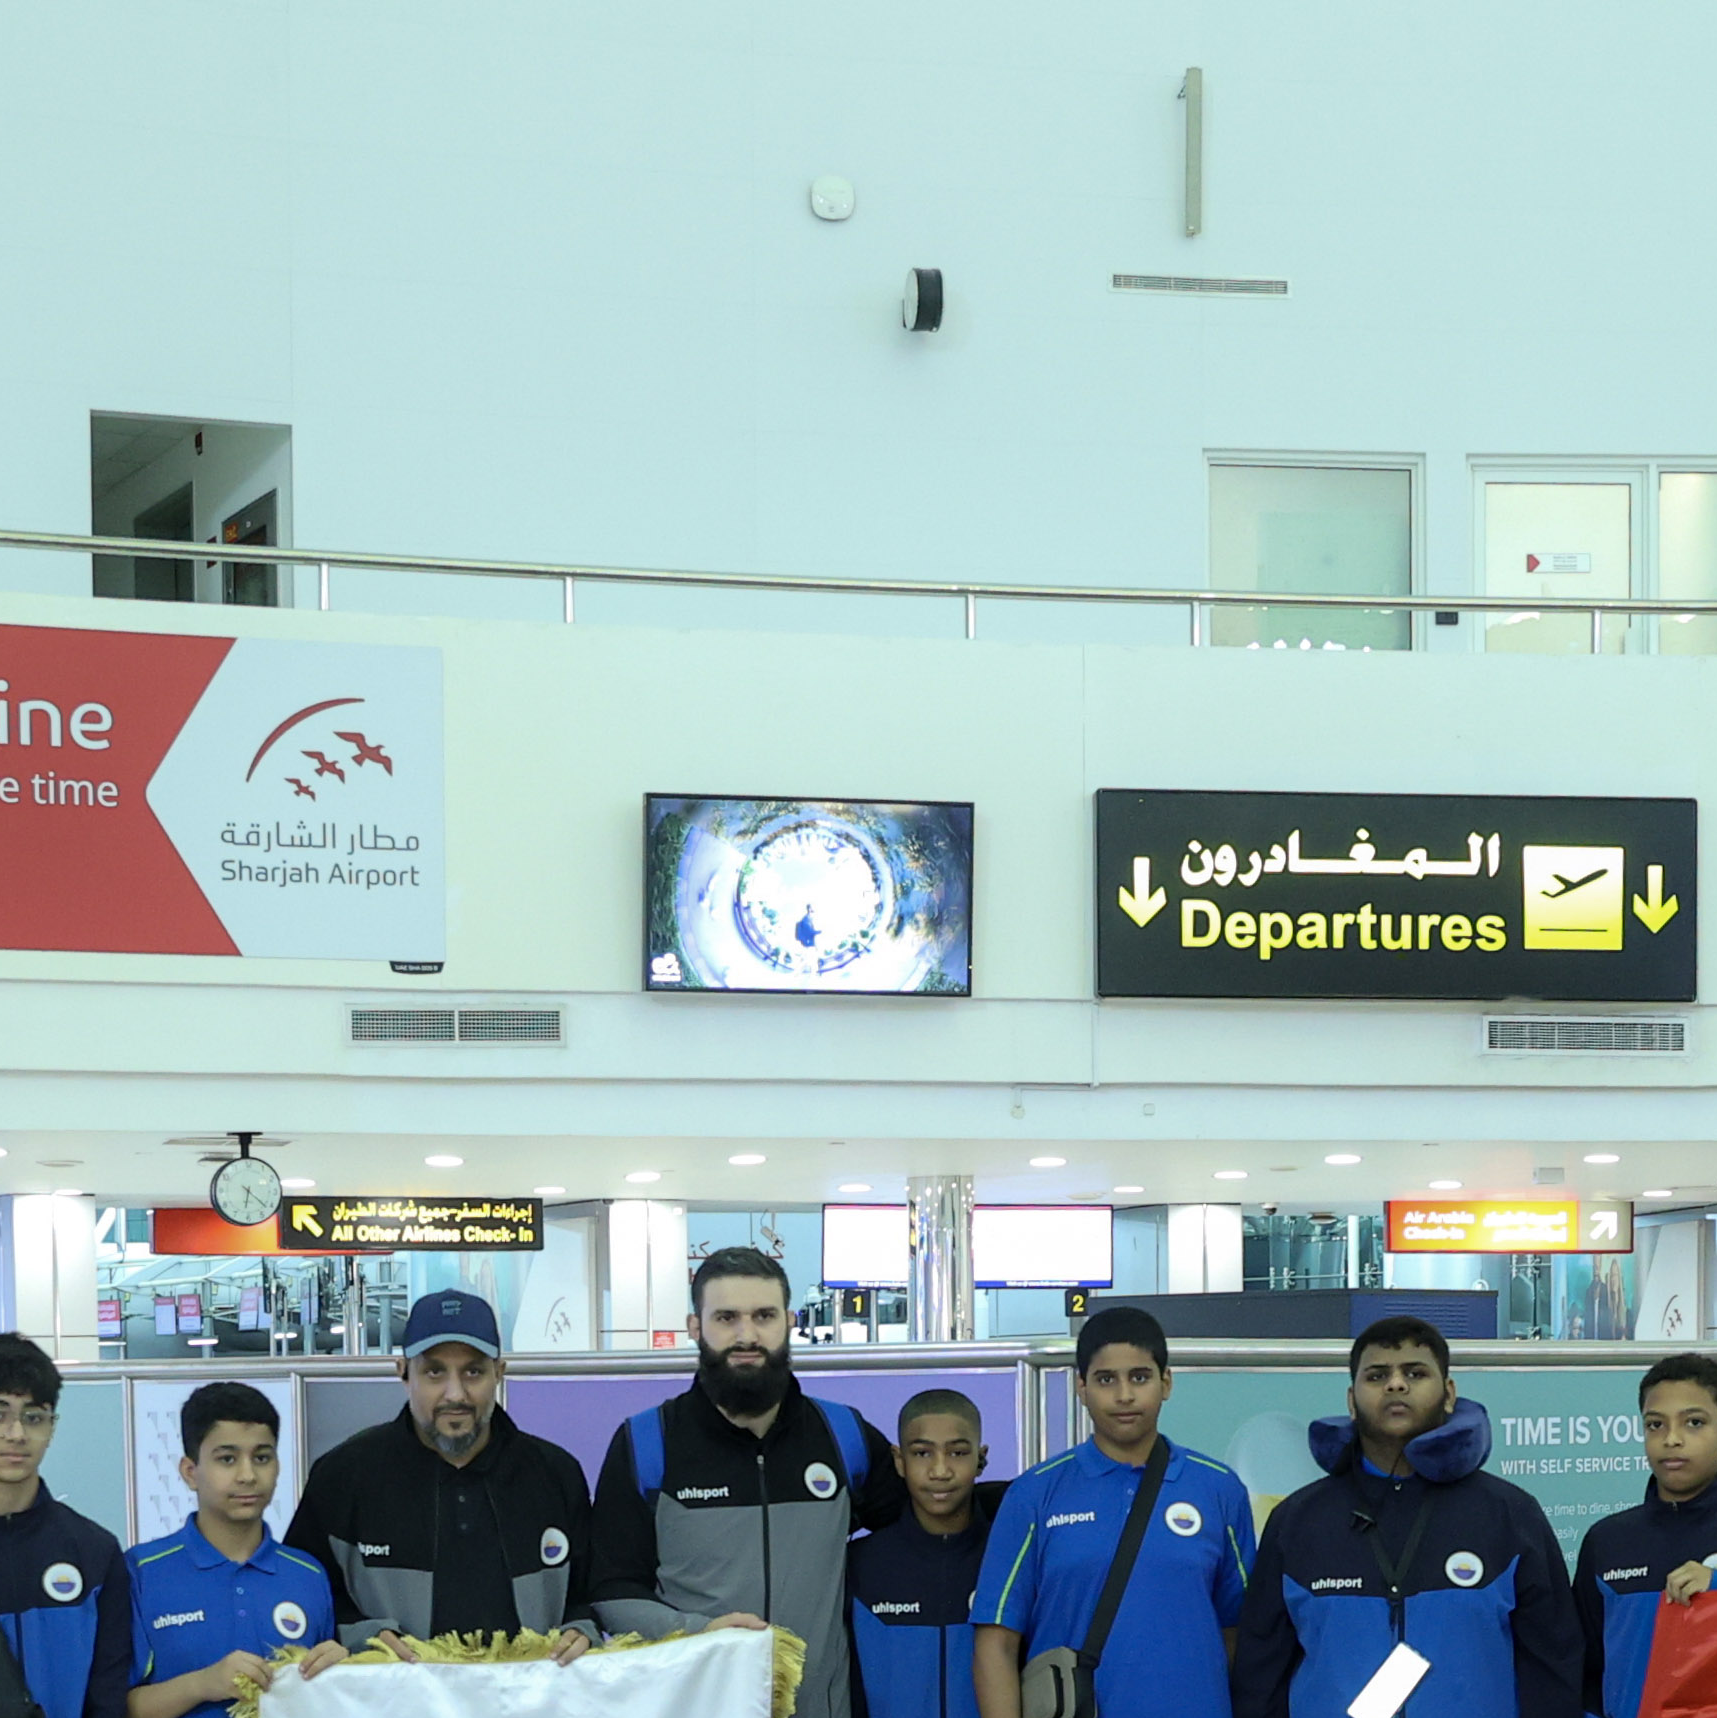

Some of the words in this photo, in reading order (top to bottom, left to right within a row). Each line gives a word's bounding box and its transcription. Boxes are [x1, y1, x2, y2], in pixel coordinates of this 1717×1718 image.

[32, 767, 118, 808] time
[220, 820, 336, 852] الشارقة
[347, 823, 420, 855] مطار
[1180, 828, 1501, 887] المغادرون
[221, 860, 319, 888] Sharjah
[328, 861, 420, 890] Airport
[1181, 899, 1507, 960] Departures
[332, 1225, 354, 1242] All
[357, 1226, 400, 1242] Other
[402, 1226, 461, 1243] Airlines
[852, 1295, 863, 1312] 1
[1072, 1295, 1084, 1312] 2
[1500, 1416, 1562, 1446] TIME
[1568, 1415, 1591, 1445] IS
[1596, 1414, 1645, 1443] YOU
[1501, 1460, 1536, 1475] WITH
[1540, 1459, 1572, 1474] SELF
[1576, 1457, 1631, 1473] SERVICE
[677, 1486, 730, 1501] uhlsport
[1554, 1503, 1575, 1516] time
[1577, 1503, 1588, 1515] to
[1046, 1511, 1095, 1528] uhlsport
[1603, 1566, 1648, 1581] uhlsport
[1311, 1577, 1363, 1590] uhlsport
[872, 1601, 920, 1616] uhlsport
[153, 1610, 205, 1630] uhlsport
